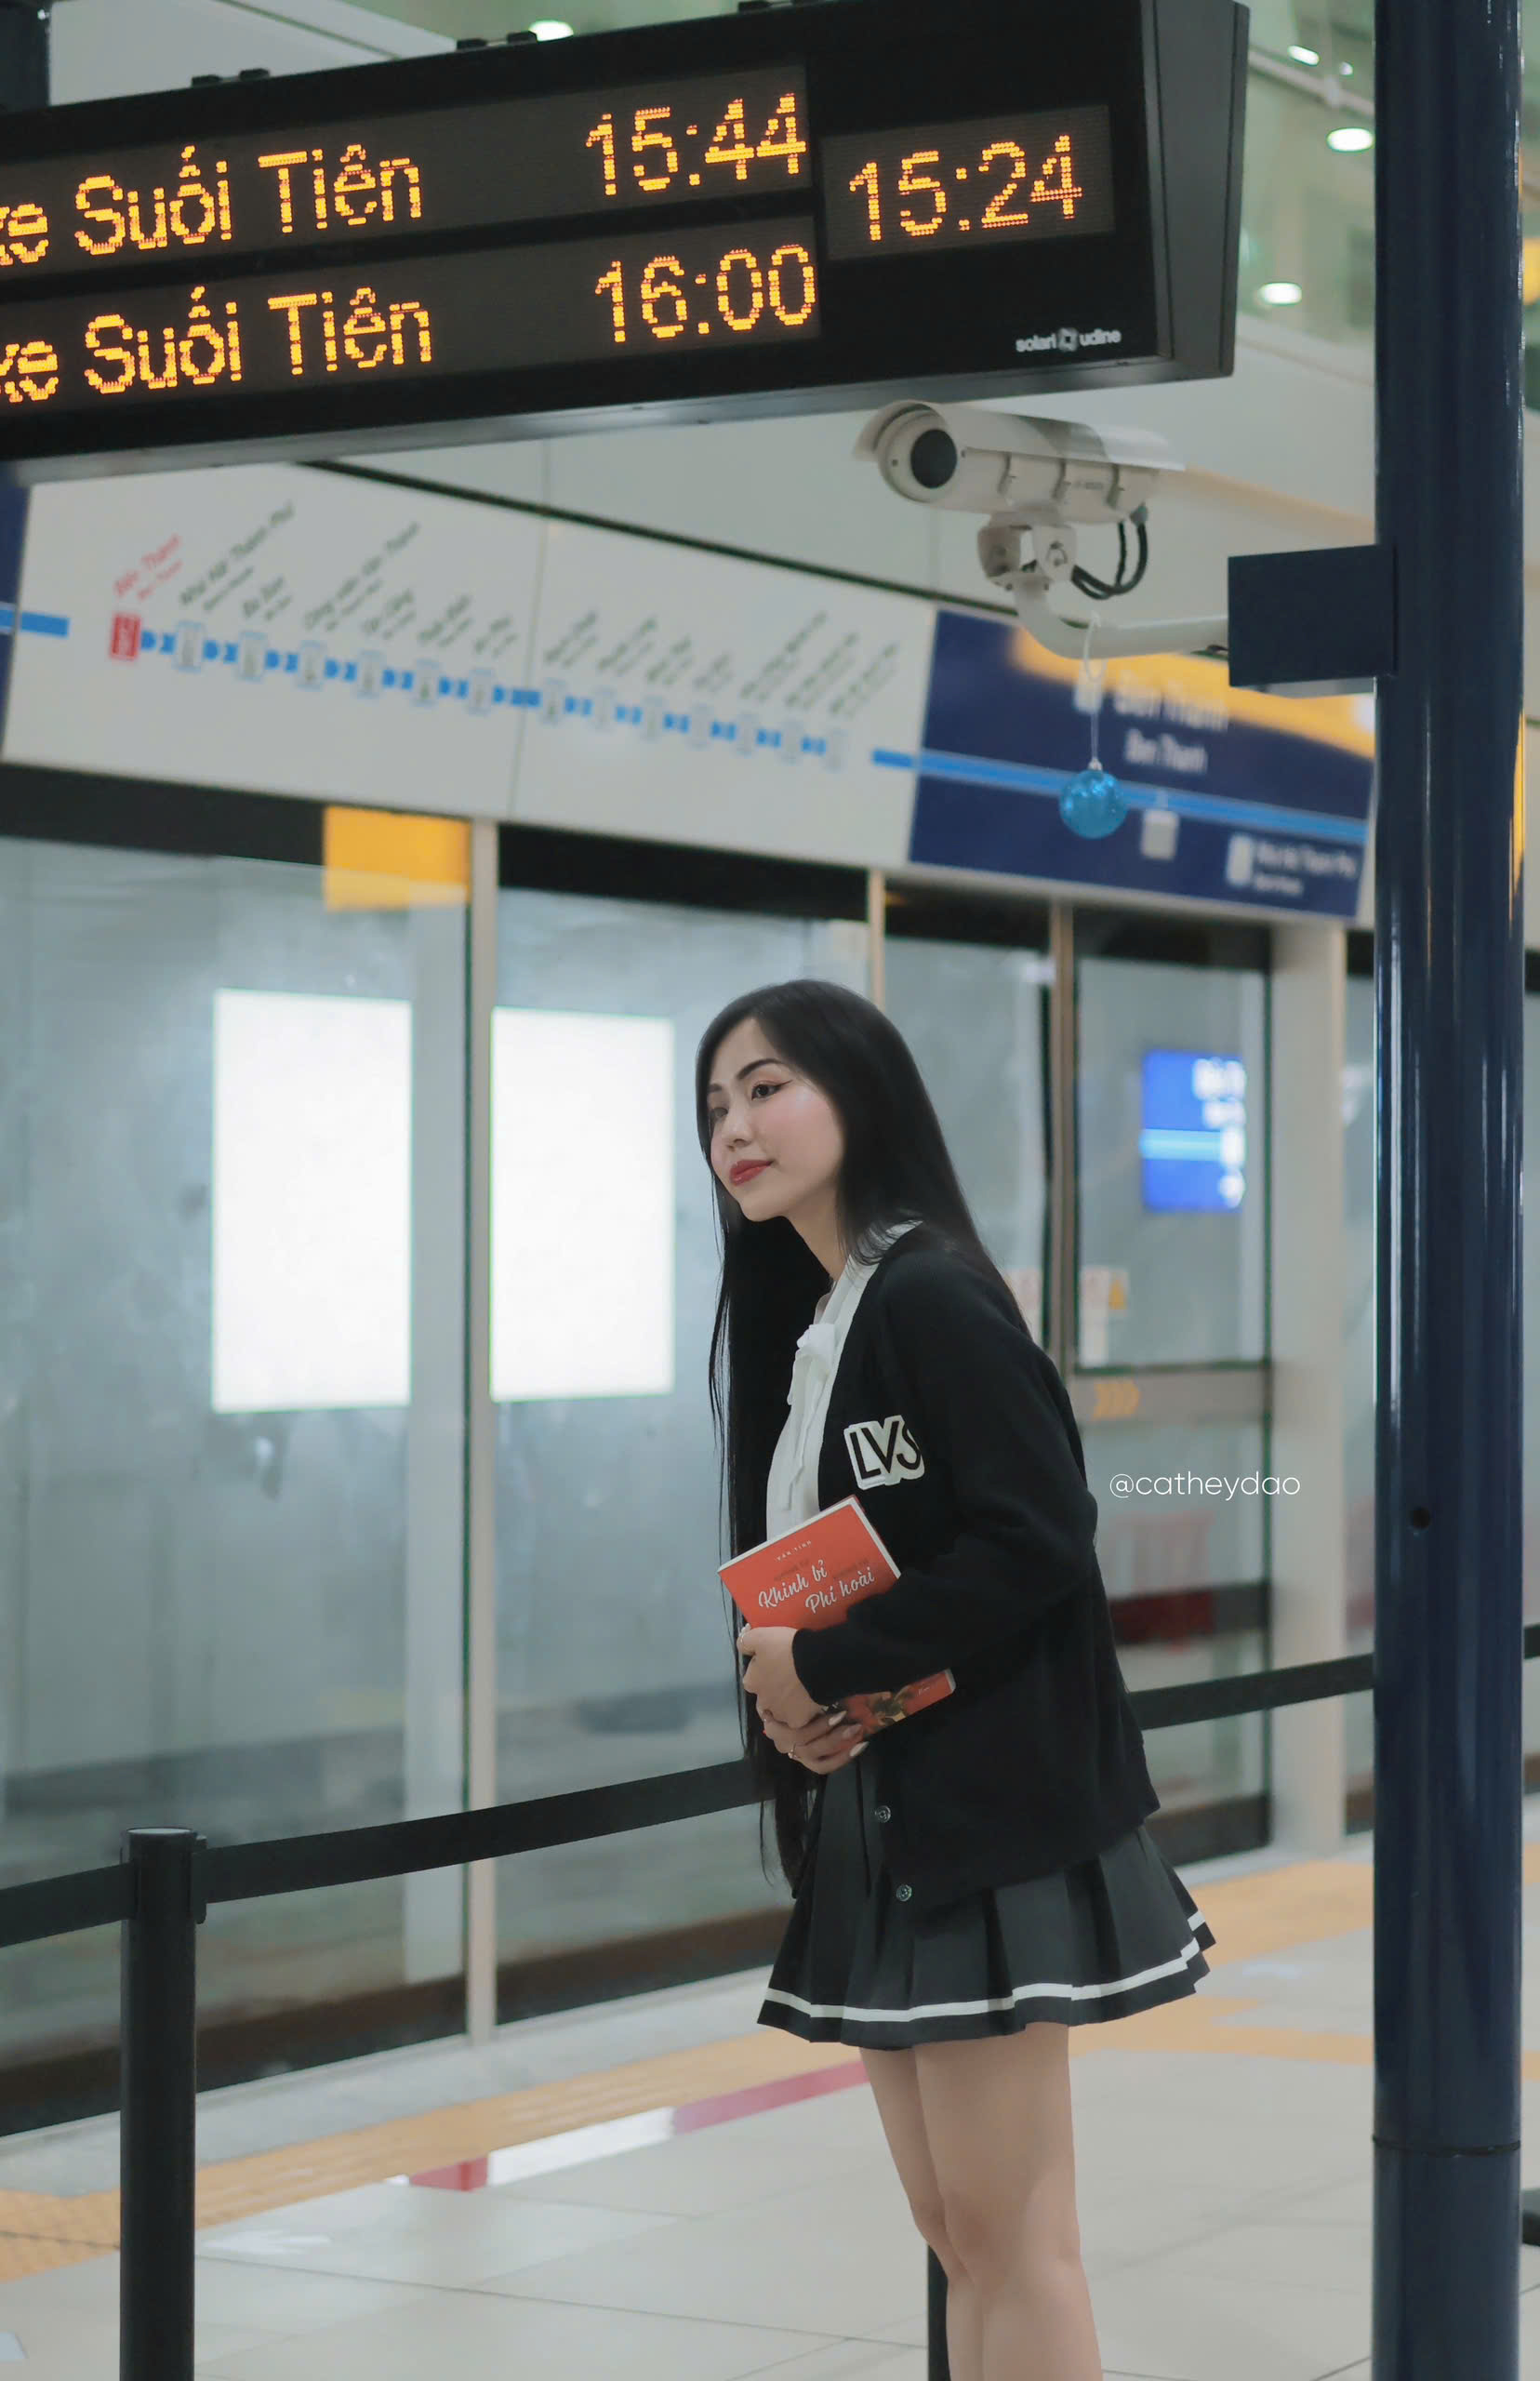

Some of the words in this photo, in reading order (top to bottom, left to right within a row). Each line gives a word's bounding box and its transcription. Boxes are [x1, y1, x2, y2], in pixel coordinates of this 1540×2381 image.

[73, 144, 232, 256] Suối
[258, 143, 422, 233] Tiên
[585, 92, 807, 196] 15:44
[849, 134, 1083, 241] 15:24
[84, 286, 243, 394] Suối
[267, 286, 432, 376] Tiên
[594, 244, 816, 343] 16:00
[758, 1574, 809, 1609] Khinh
[804, 1585, 838, 1615] Phí
[839, 1566, 875, 1597] hoài
